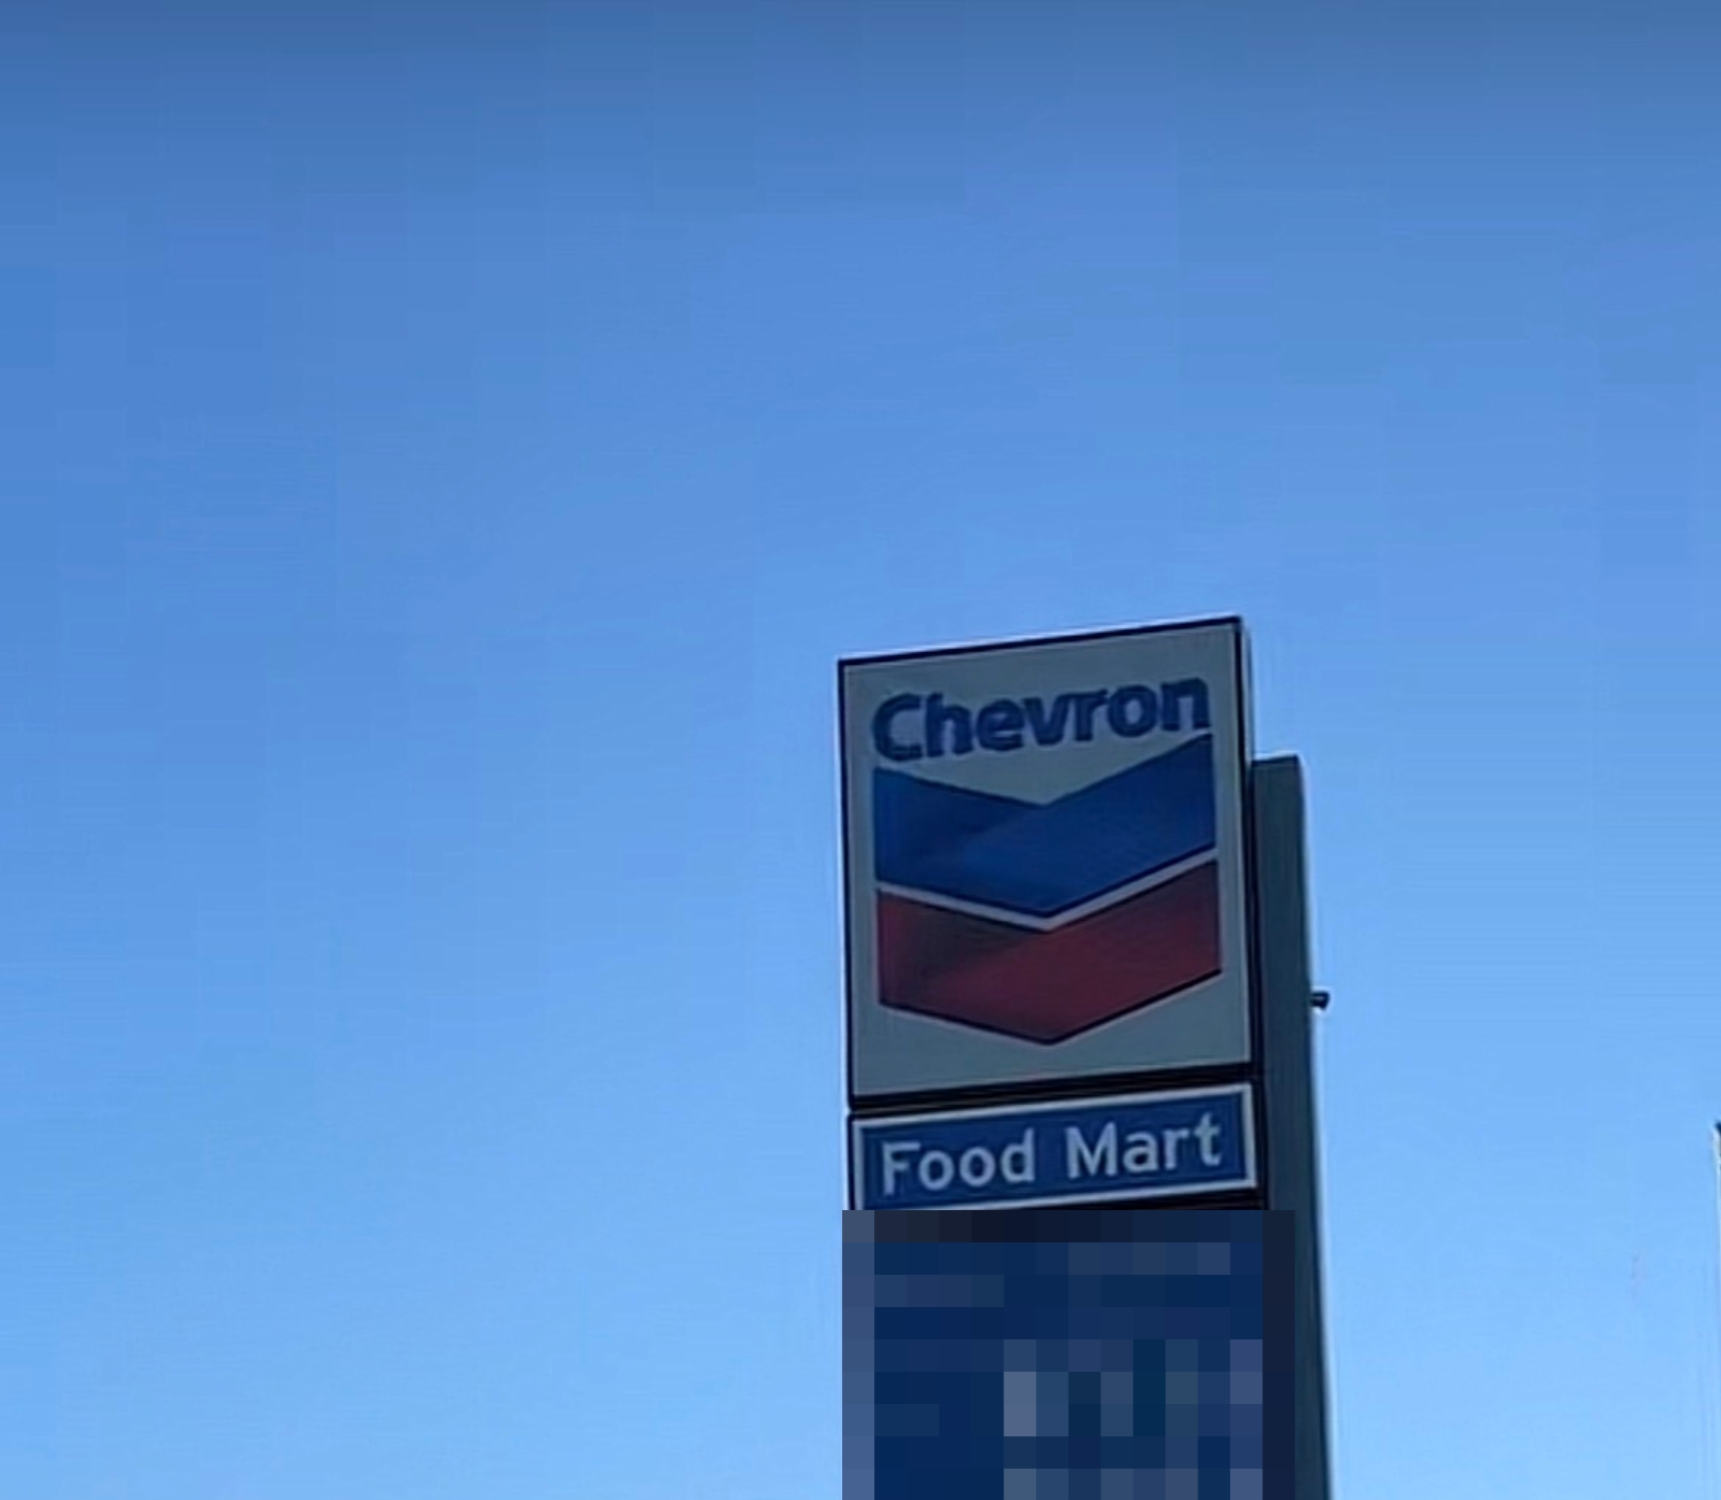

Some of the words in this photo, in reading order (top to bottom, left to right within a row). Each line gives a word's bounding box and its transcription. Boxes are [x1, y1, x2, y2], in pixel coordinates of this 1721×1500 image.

[871, 677, 1211, 762] Chevron
[882, 1127, 1036, 1195] Food
[1065, 1112, 1222, 1179] Mart
